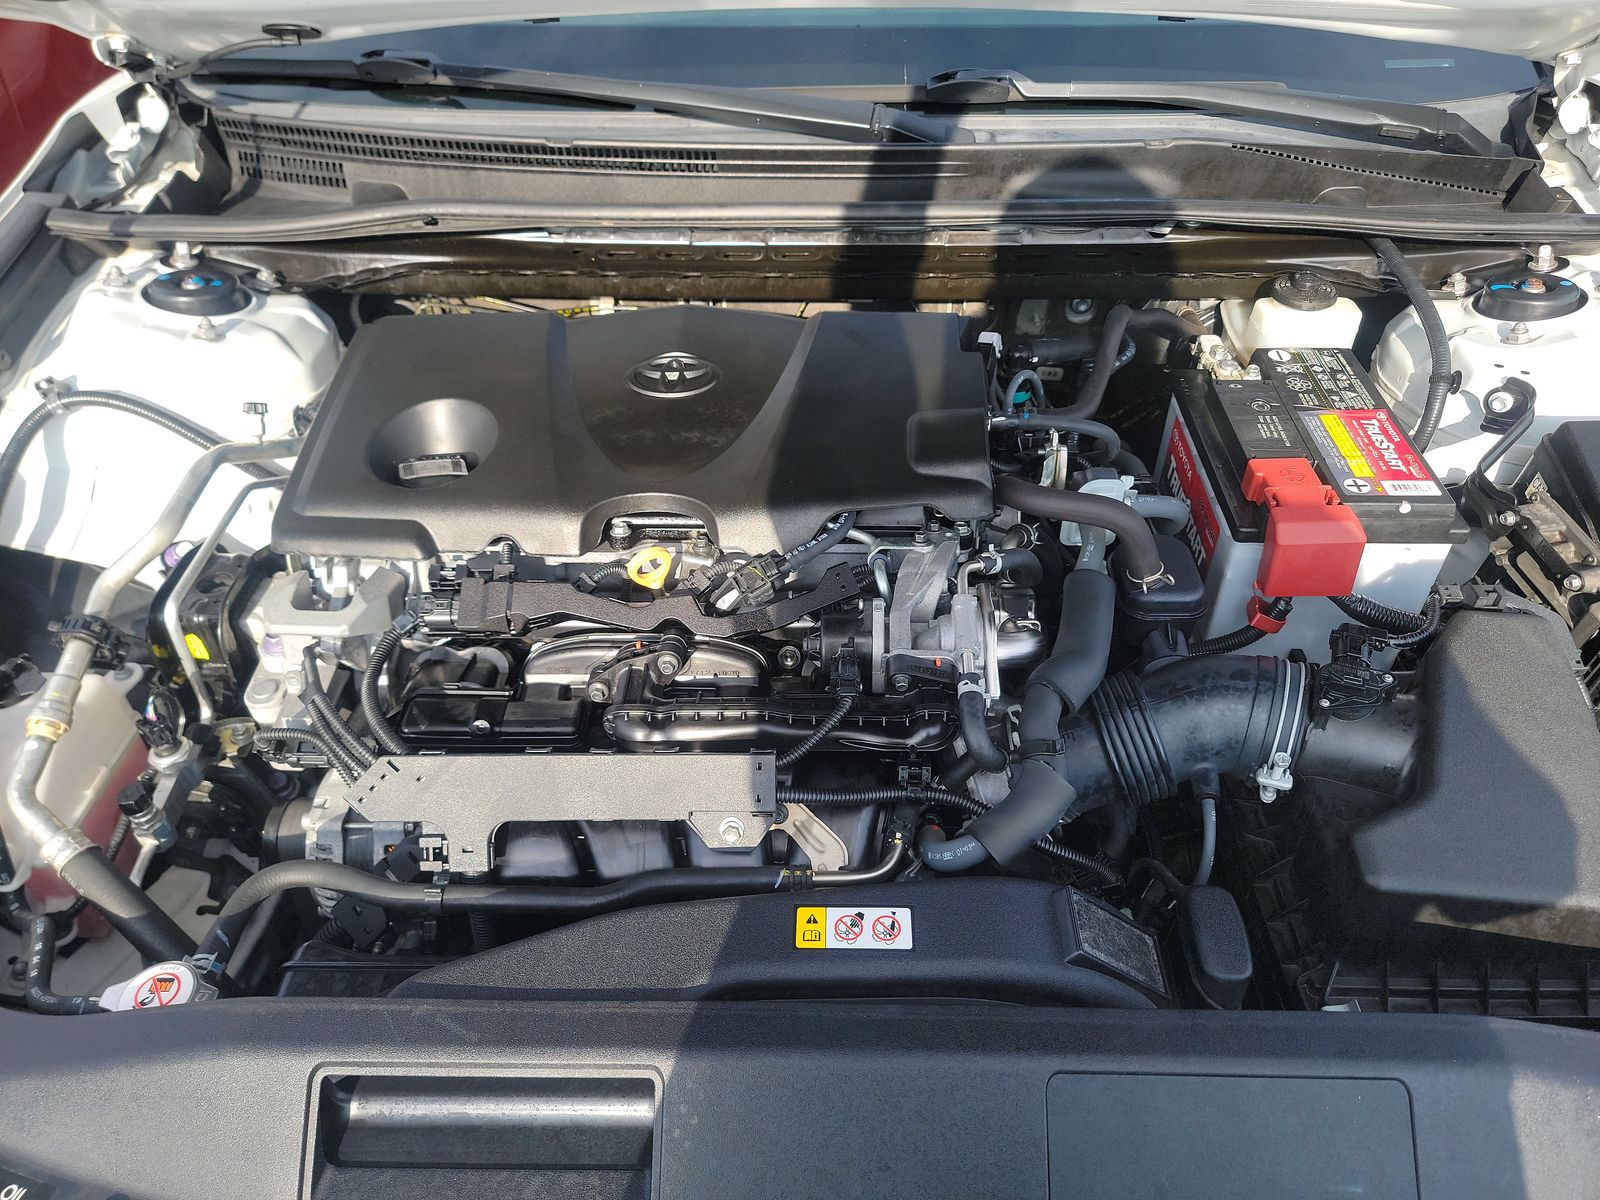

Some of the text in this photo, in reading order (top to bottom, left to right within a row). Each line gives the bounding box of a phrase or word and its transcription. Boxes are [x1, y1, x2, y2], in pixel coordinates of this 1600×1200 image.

[1360, 419, 1405, 472] TRUESTART
[1382, 420, 1400, 442] TOYOTA
[1176, 440, 1192, 481] TOYOTA
